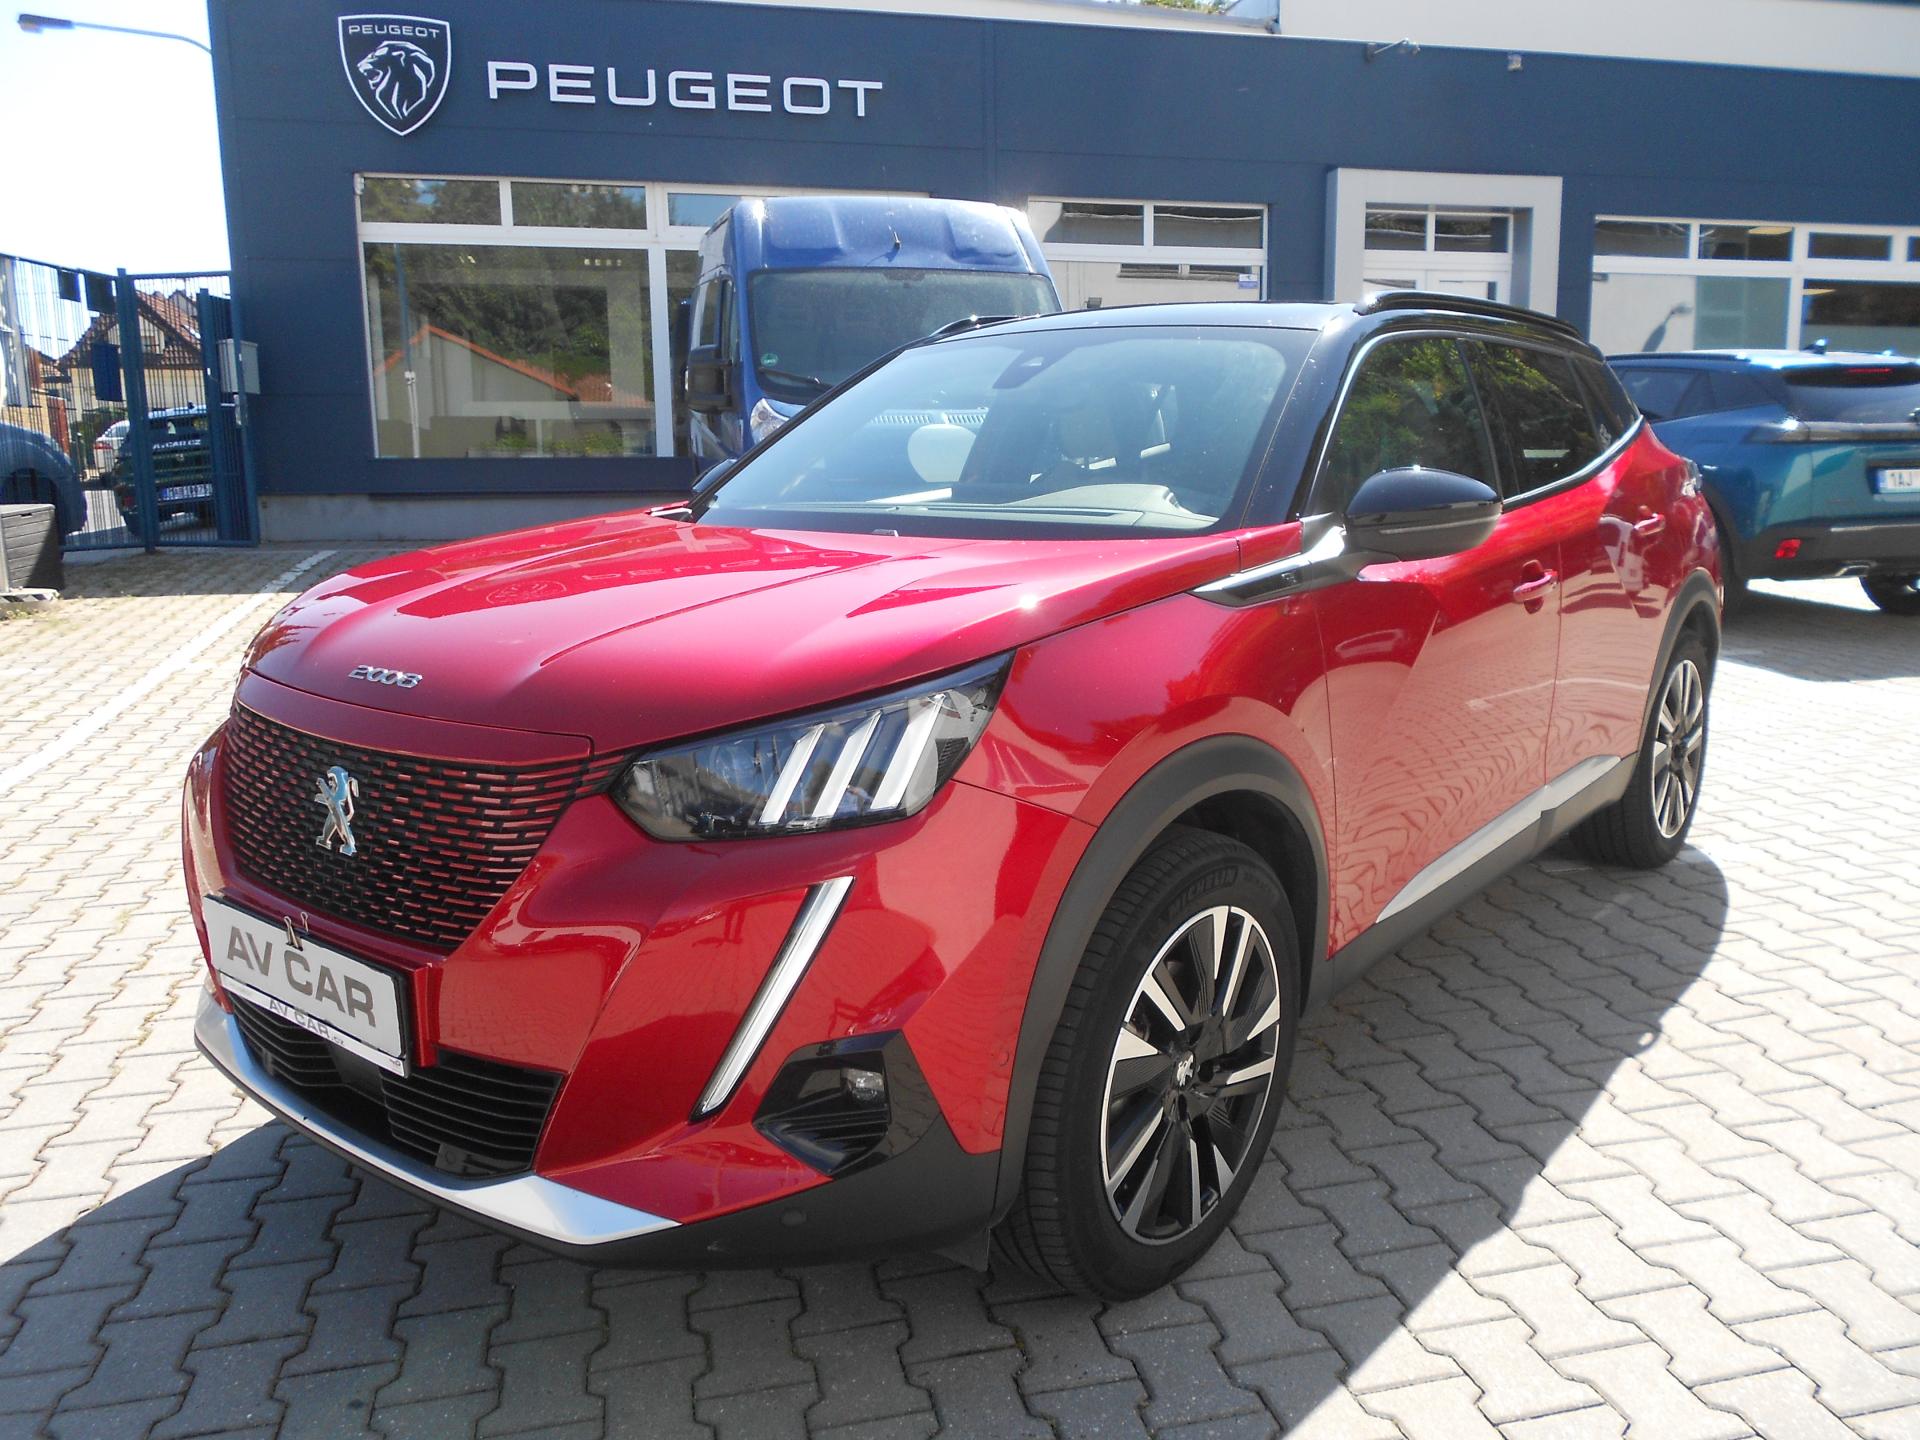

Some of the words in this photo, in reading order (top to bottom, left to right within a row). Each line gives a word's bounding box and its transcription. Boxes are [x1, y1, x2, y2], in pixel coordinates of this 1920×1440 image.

[348, 24, 440, 38] PEUGEOT
[487, 61, 883, 117] PEUGEOT
[348, 664, 423, 688] 2008
[227, 926, 273, 977] AV
[284, 950, 376, 1028] CAR
[269, 999, 289, 1018] AV
